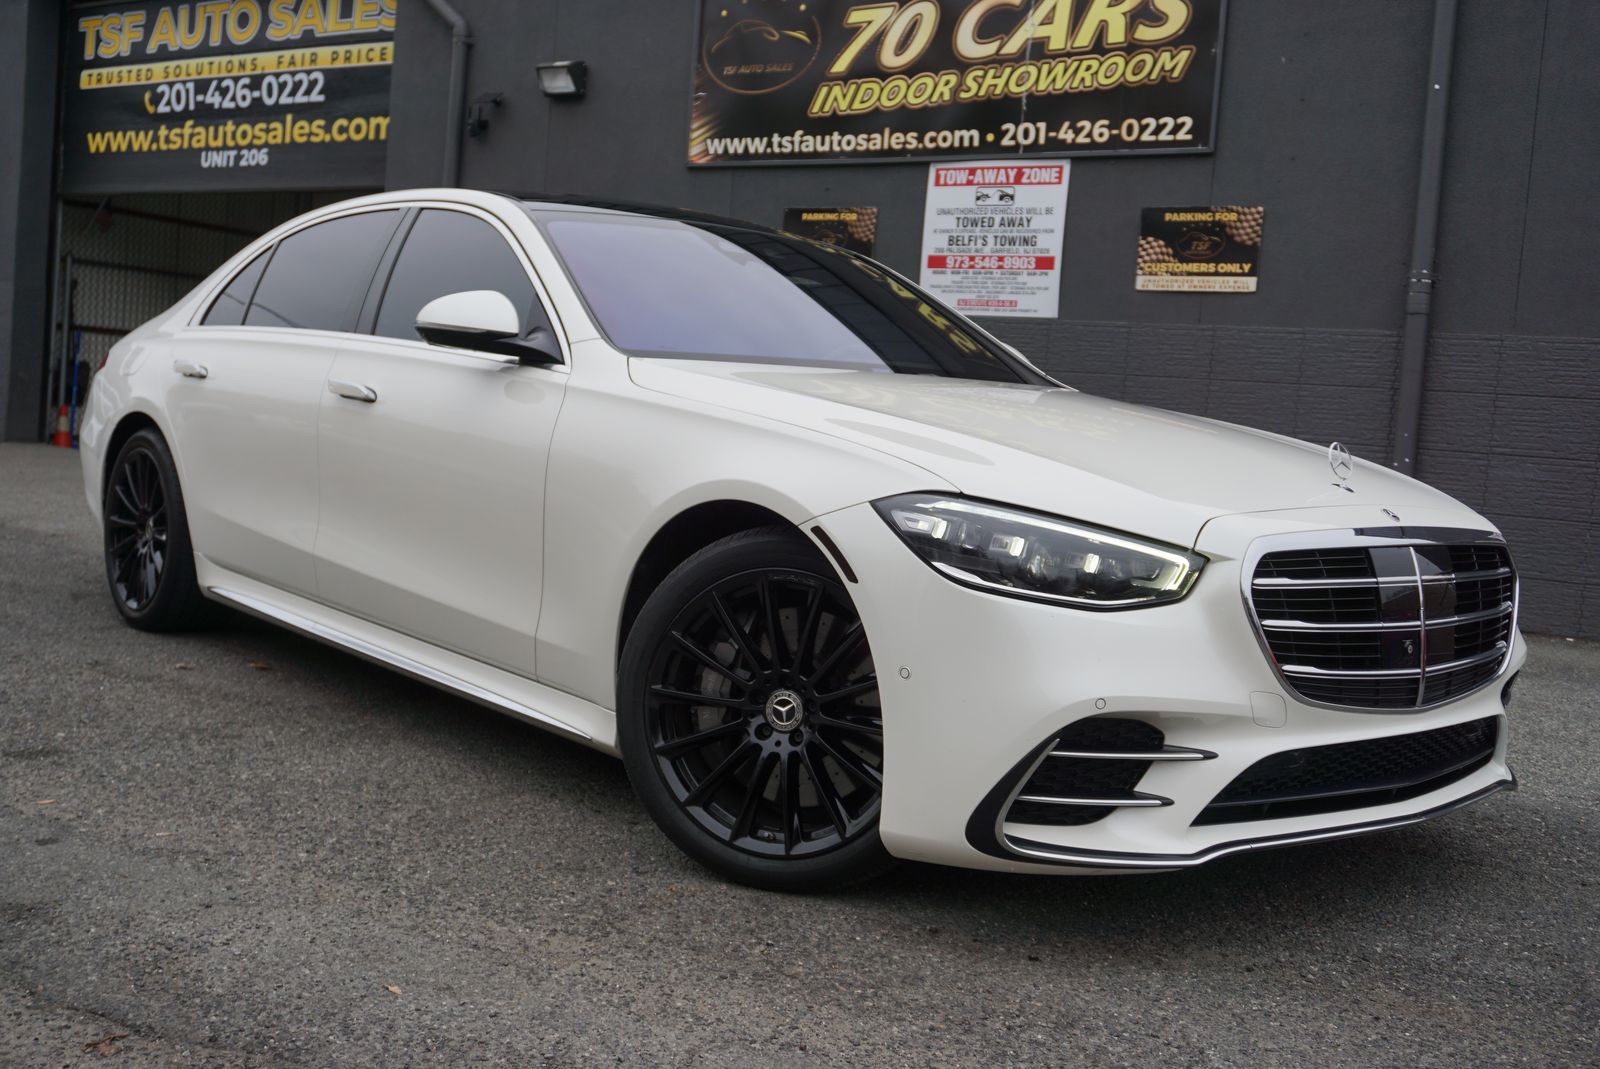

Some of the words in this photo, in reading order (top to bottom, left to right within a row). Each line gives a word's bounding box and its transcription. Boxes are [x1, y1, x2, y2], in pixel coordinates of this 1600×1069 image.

[79, 11, 146, 60] TSF
[146, 0, 261, 53] AUTO
[828, 0, 940, 75] 70
[951, 0, 1192, 61] CARS
[87, 68, 154, 86] TRUSTED
[162, 57, 267, 79] SOLUTIONS,
[276, 51, 319, 69] FAIR
[738, 63, 765, 74] AUTO
[765, 62, 795, 72] SALES
[808, 70, 957, 117] INDOOR
[959, 45, 1195, 100] SHOWROOM
[156, 71, 325, 114] 201-426-0222
[87, 114, 390, 153] www.tsfautosales.com
[706, 125, 980, 155] www.tsfautosales.com
[1000, 115, 1193, 147] 201-426-0222
[201, 150, 238, 168] UNIT
[239, 148, 269, 166] 206
[939, 168, 1018, 184] TOW-AWAY
[1021, 167, 1059, 183] ZONE
[801, 212, 839, 221] PARKING
[936, 207, 989, 216] UNAUTHORIZED
[990, 207, 1024, 215] VEHICLES
[1026, 207, 1044, 215] WILL
[1045, 206, 1054, 215] BE
[1164, 212, 1213, 222] PARKING
[1215, 212, 1238, 221] FOR
[956, 216, 995, 228] TOWED
[998, 216, 1033, 228] AWAY
[947, 235, 988, 247] BELFI'S
[993, 235, 1037, 247] TOWING
[1190, 240, 1212, 251] TSF
[1143, 263, 1216, 273] CUSTOMERS
[1217, 263, 1252, 273] ONLY
